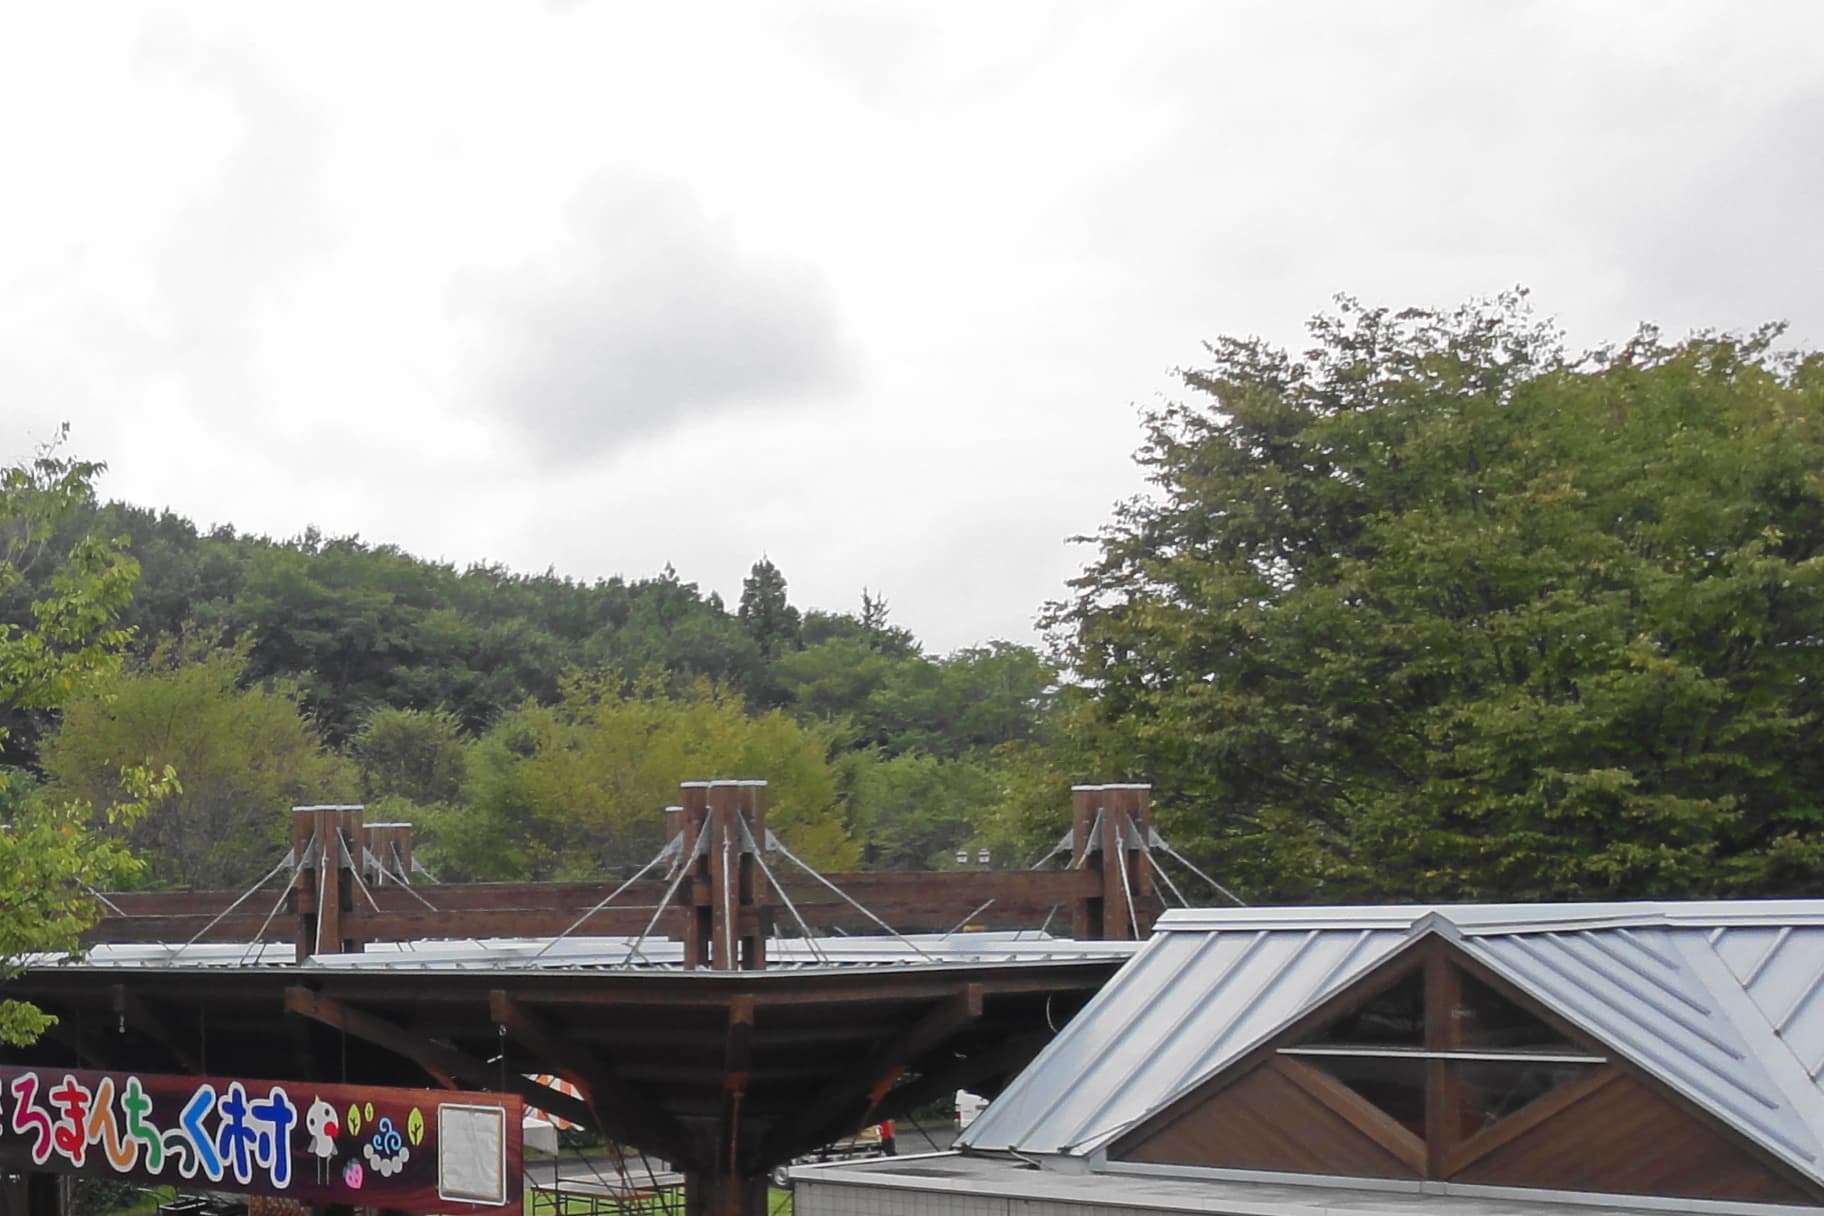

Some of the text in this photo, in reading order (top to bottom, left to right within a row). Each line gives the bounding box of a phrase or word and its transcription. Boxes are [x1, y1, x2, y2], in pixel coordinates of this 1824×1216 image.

[11, 1071, 298, 1189] ろまんちっく村
